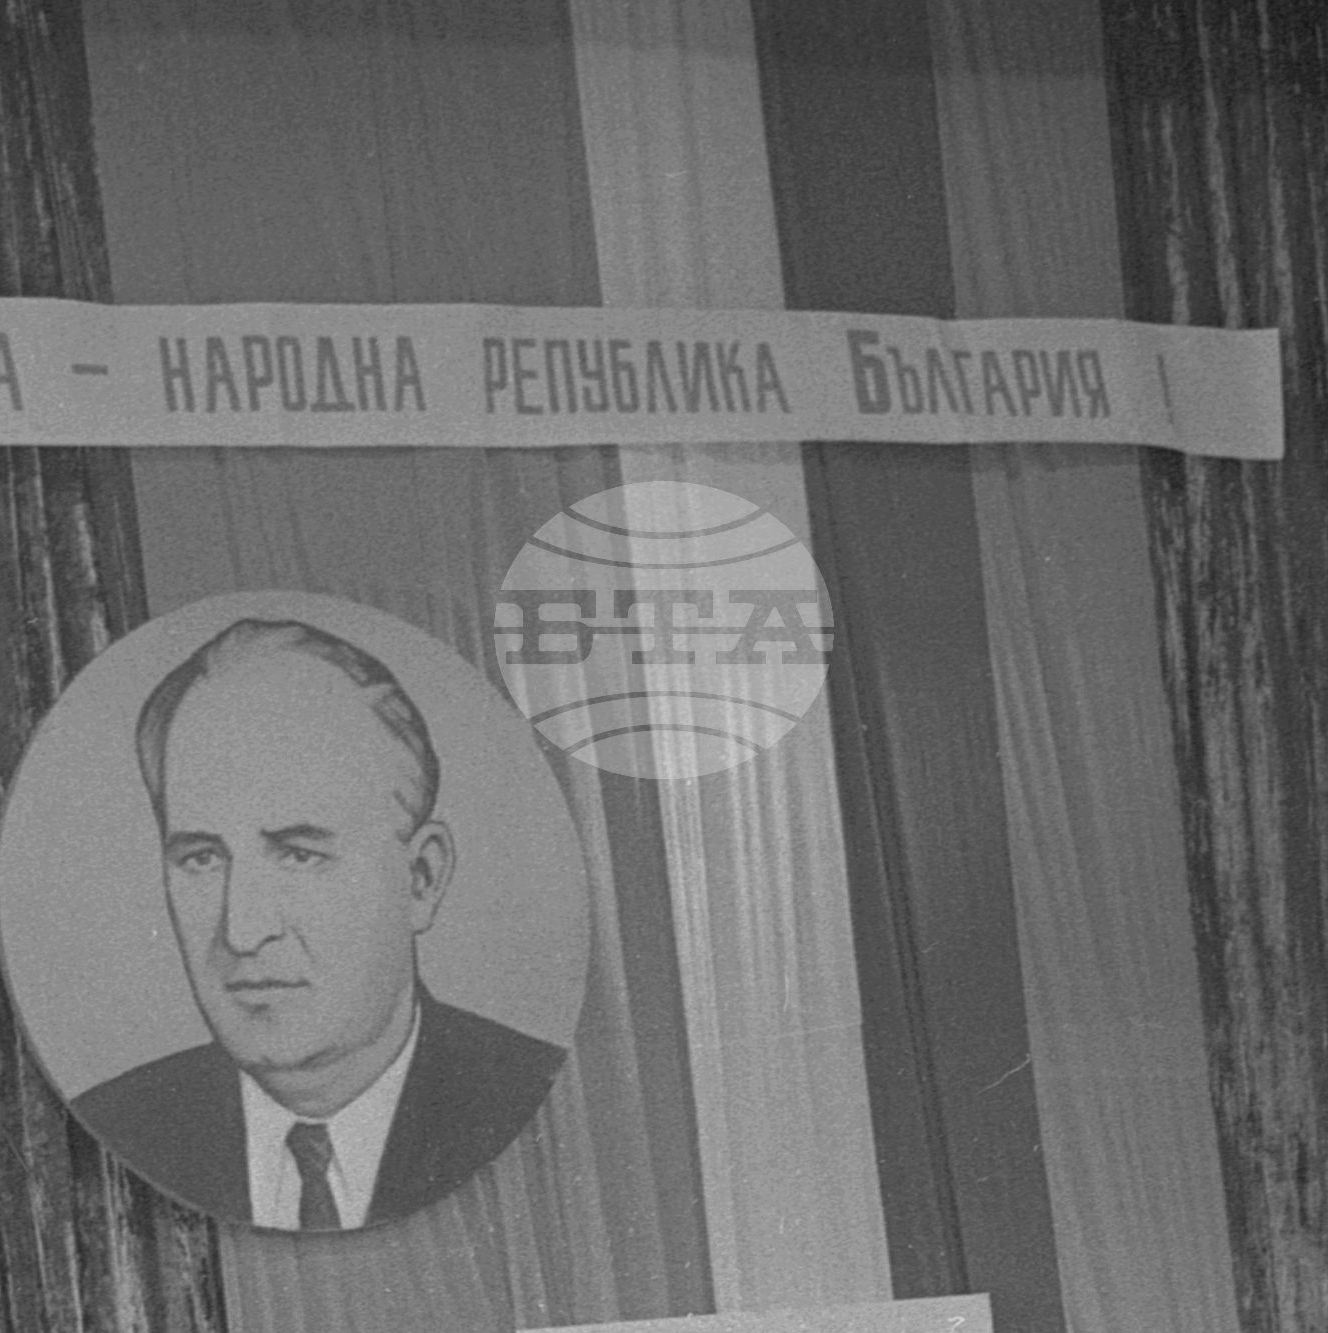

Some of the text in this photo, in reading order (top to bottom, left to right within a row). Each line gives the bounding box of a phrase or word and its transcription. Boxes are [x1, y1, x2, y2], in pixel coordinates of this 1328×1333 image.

[159, 335, 427, 413] НАРОДНА
[483, 336, 792, 415] РЕПУБЛИКА
[845, 329, 1111, 418] БЪЛГАРИЯ
